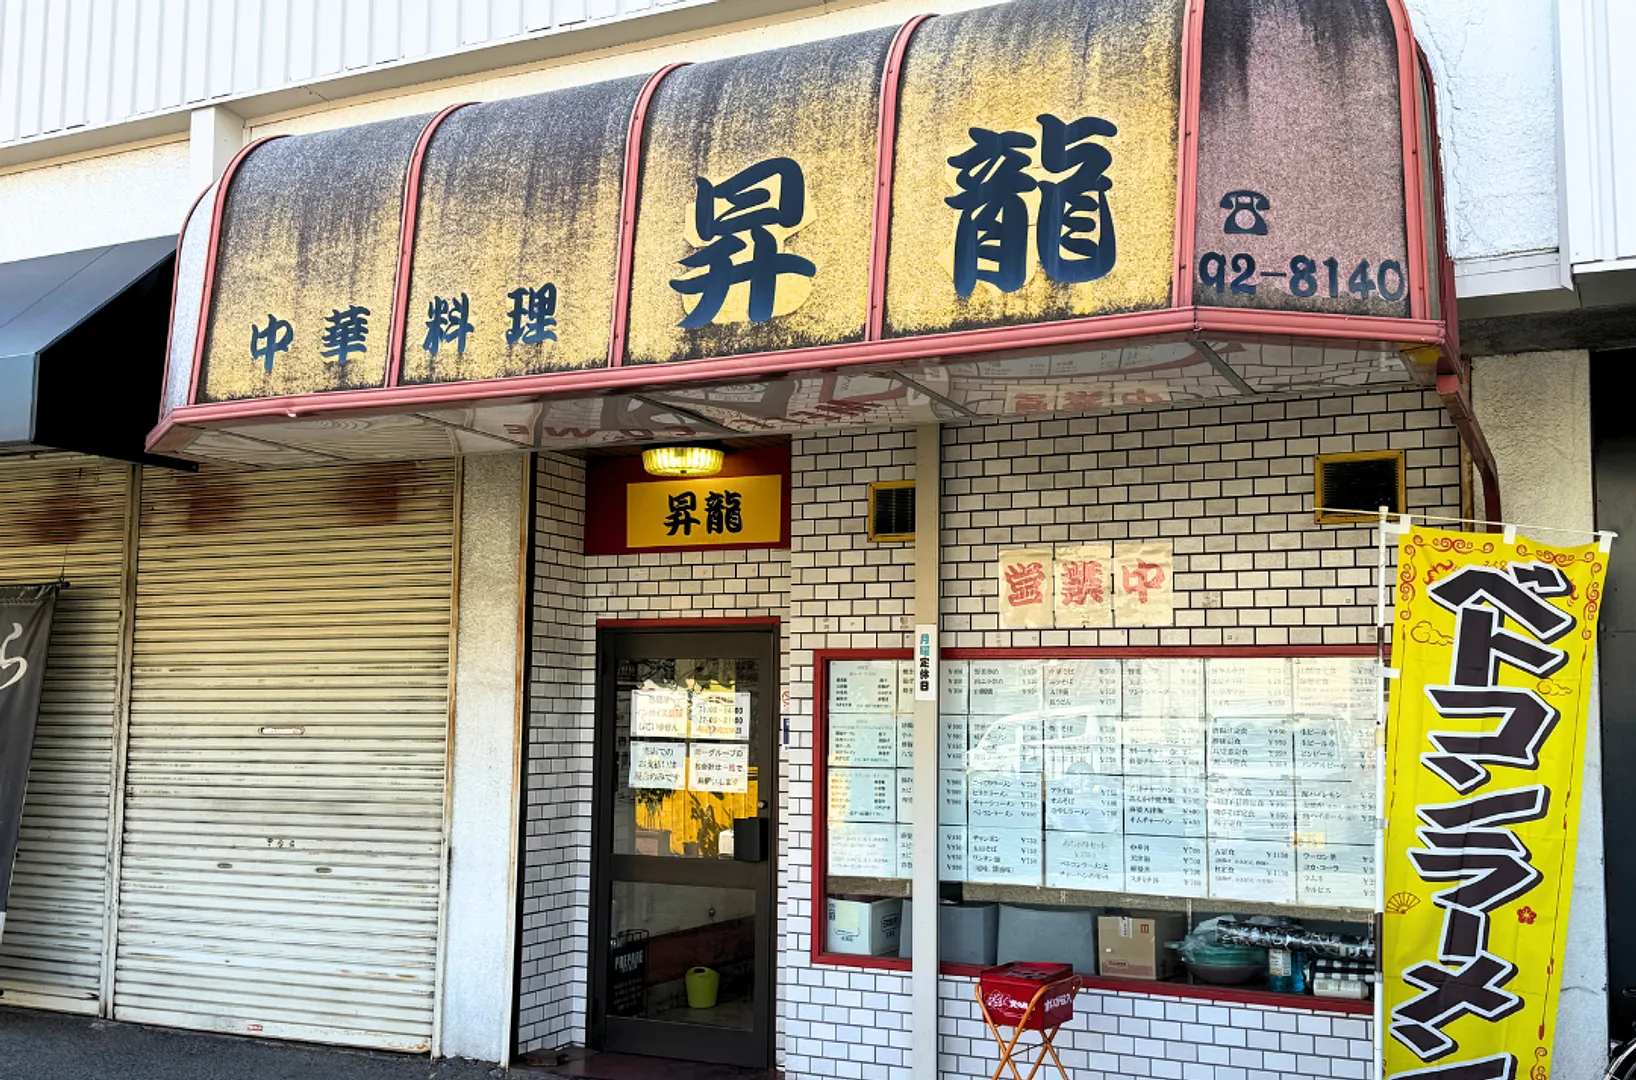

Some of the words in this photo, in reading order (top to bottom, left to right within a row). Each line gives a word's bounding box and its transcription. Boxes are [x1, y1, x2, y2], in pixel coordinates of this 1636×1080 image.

[669, 113, 1119, 330] 昇龍
[1198, 250, 1408, 301] 92-8140
[249, 281, 559, 371] 中華料理
[663, 489, 743, 536] 昇龍
[1004, 557, 1166, 607] 営業中
[919, 633, 930, 692] 月曜定休日
